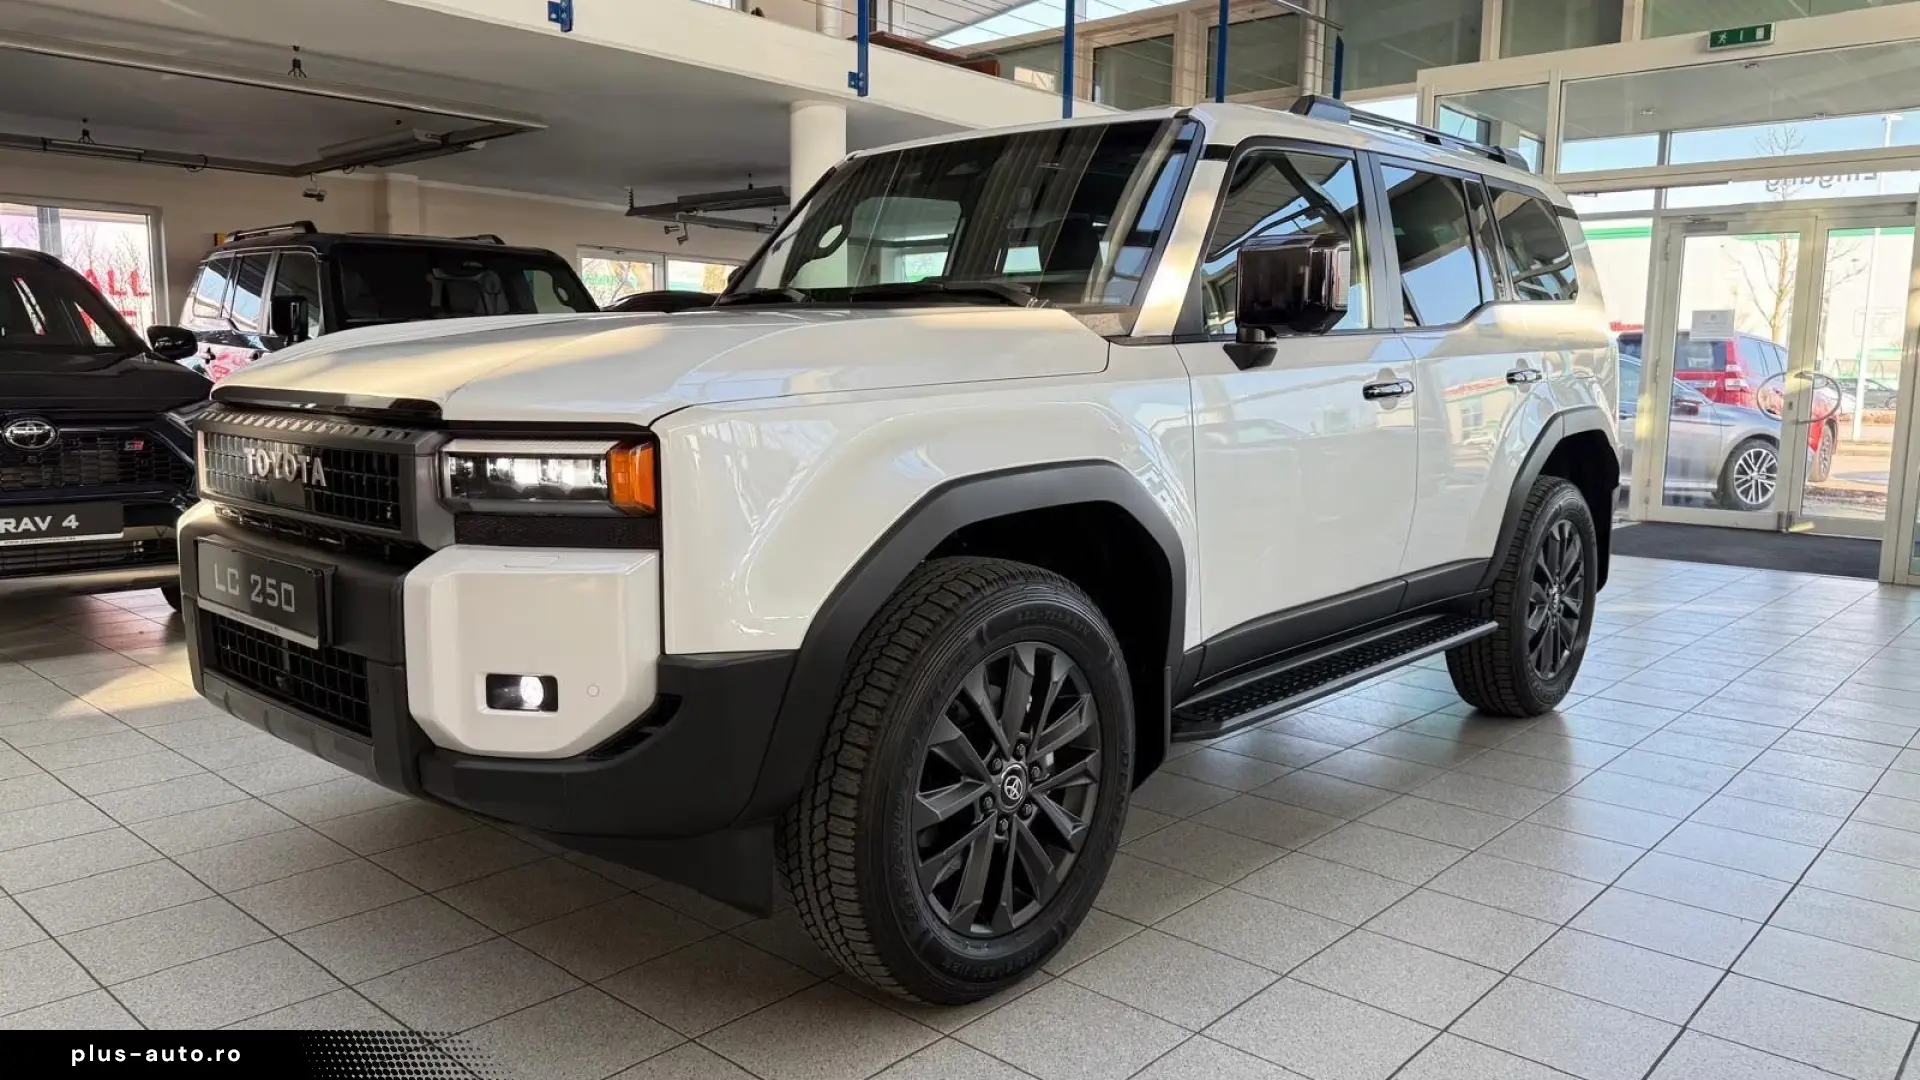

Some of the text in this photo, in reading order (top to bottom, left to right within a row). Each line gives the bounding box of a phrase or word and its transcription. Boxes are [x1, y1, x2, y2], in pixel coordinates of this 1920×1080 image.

[243, 448, 327, 487] TOYOTA
[0, 514, 79, 534] RAV 4
[214, 563, 296, 613] LC 250
